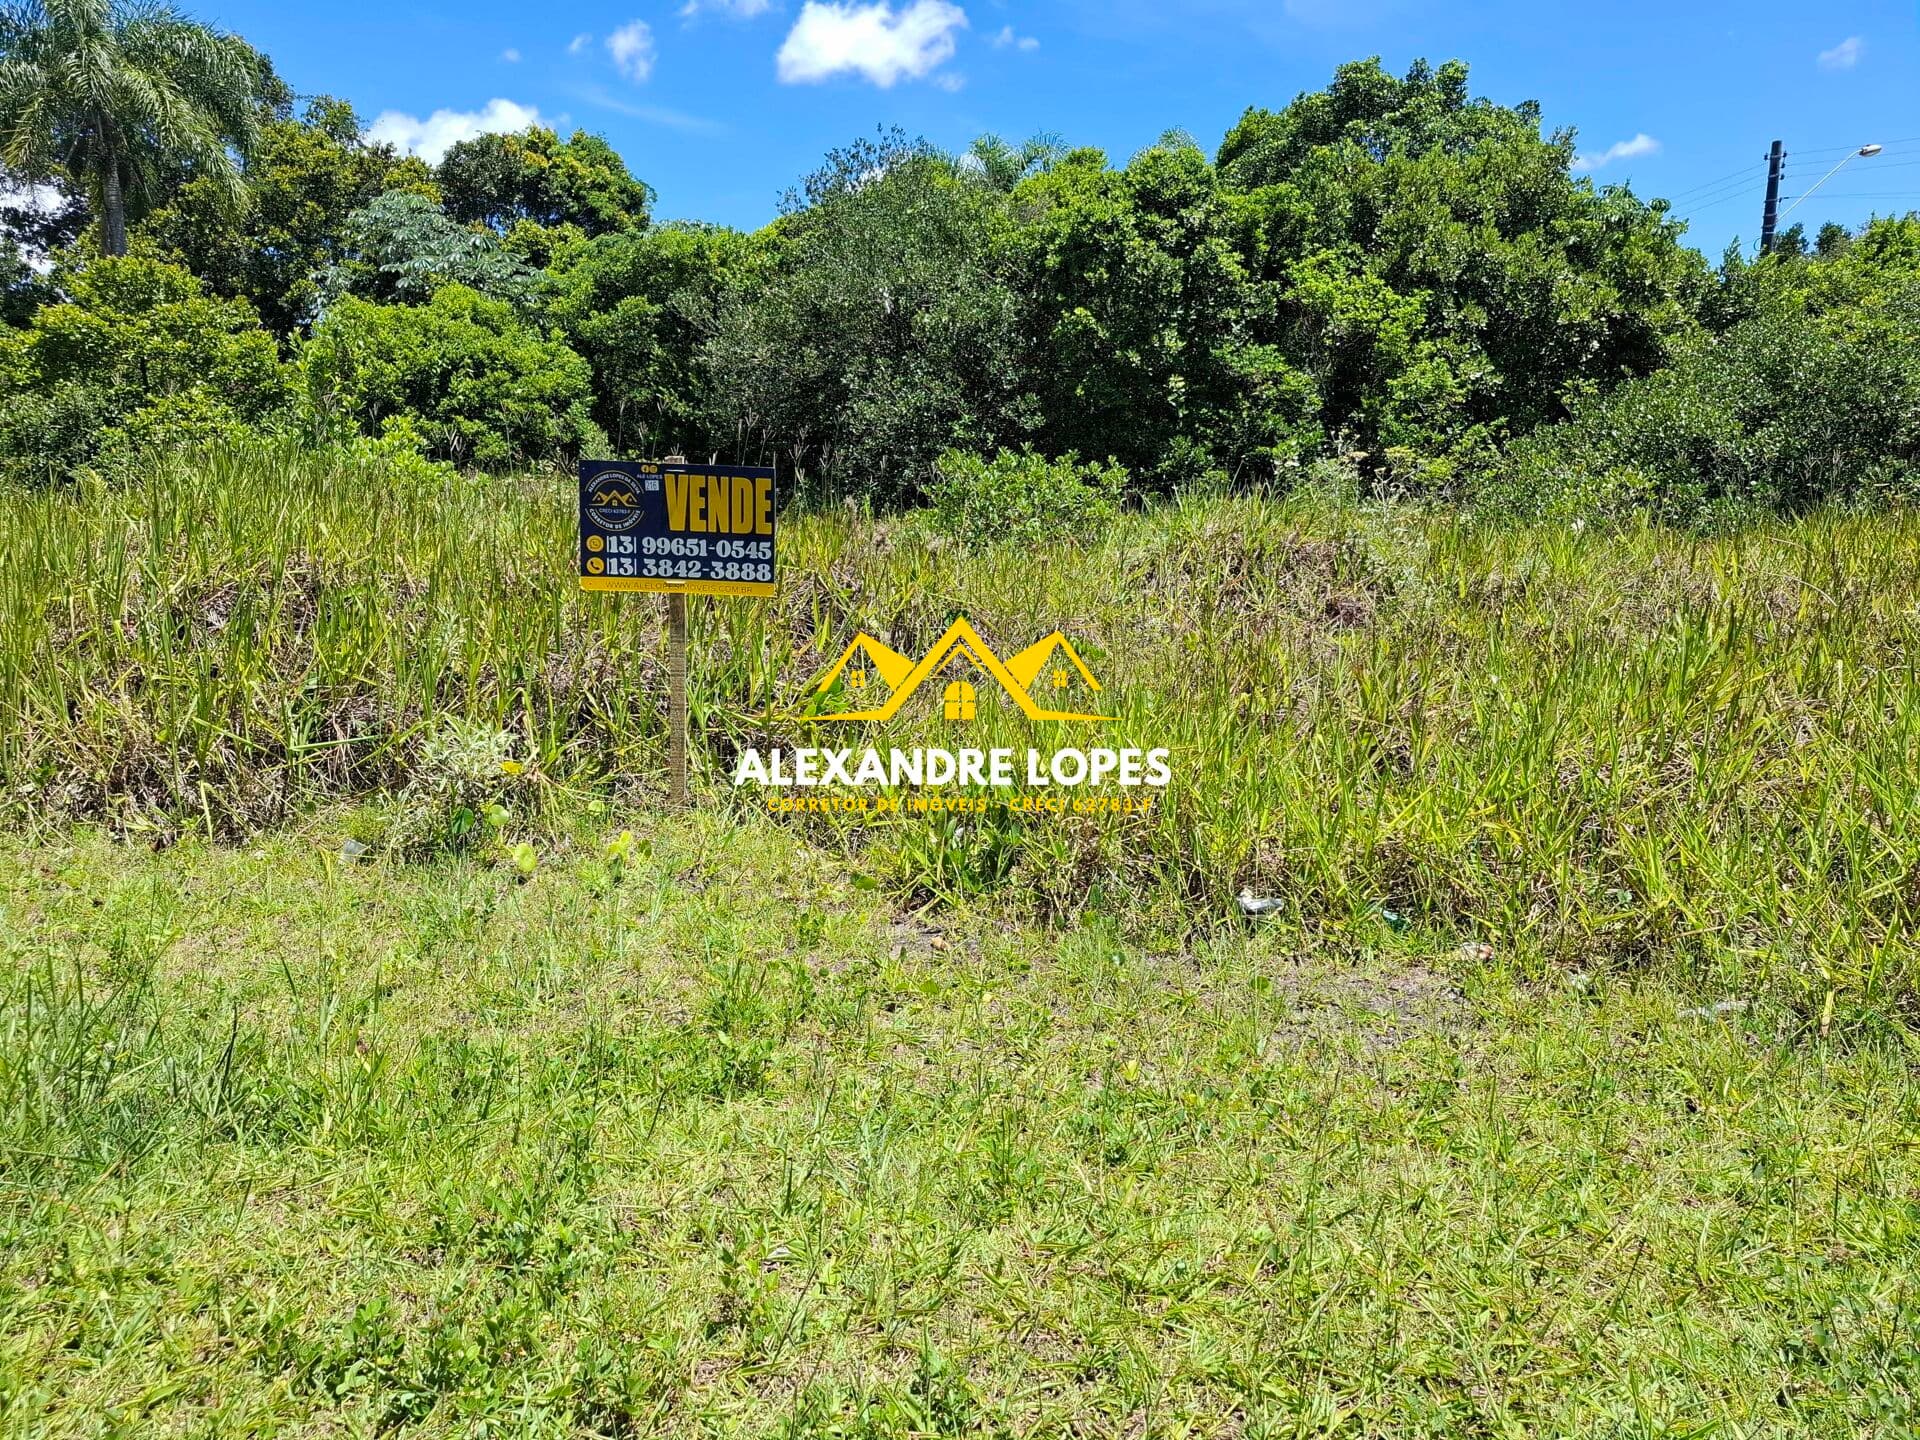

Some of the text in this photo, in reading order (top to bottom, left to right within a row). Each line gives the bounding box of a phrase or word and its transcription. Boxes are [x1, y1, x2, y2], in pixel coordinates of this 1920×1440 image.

[664, 473, 773, 535] VENDE
[642, 536, 772, 560] 99651-0545
[642, 558, 772, 582] 3842-3888
